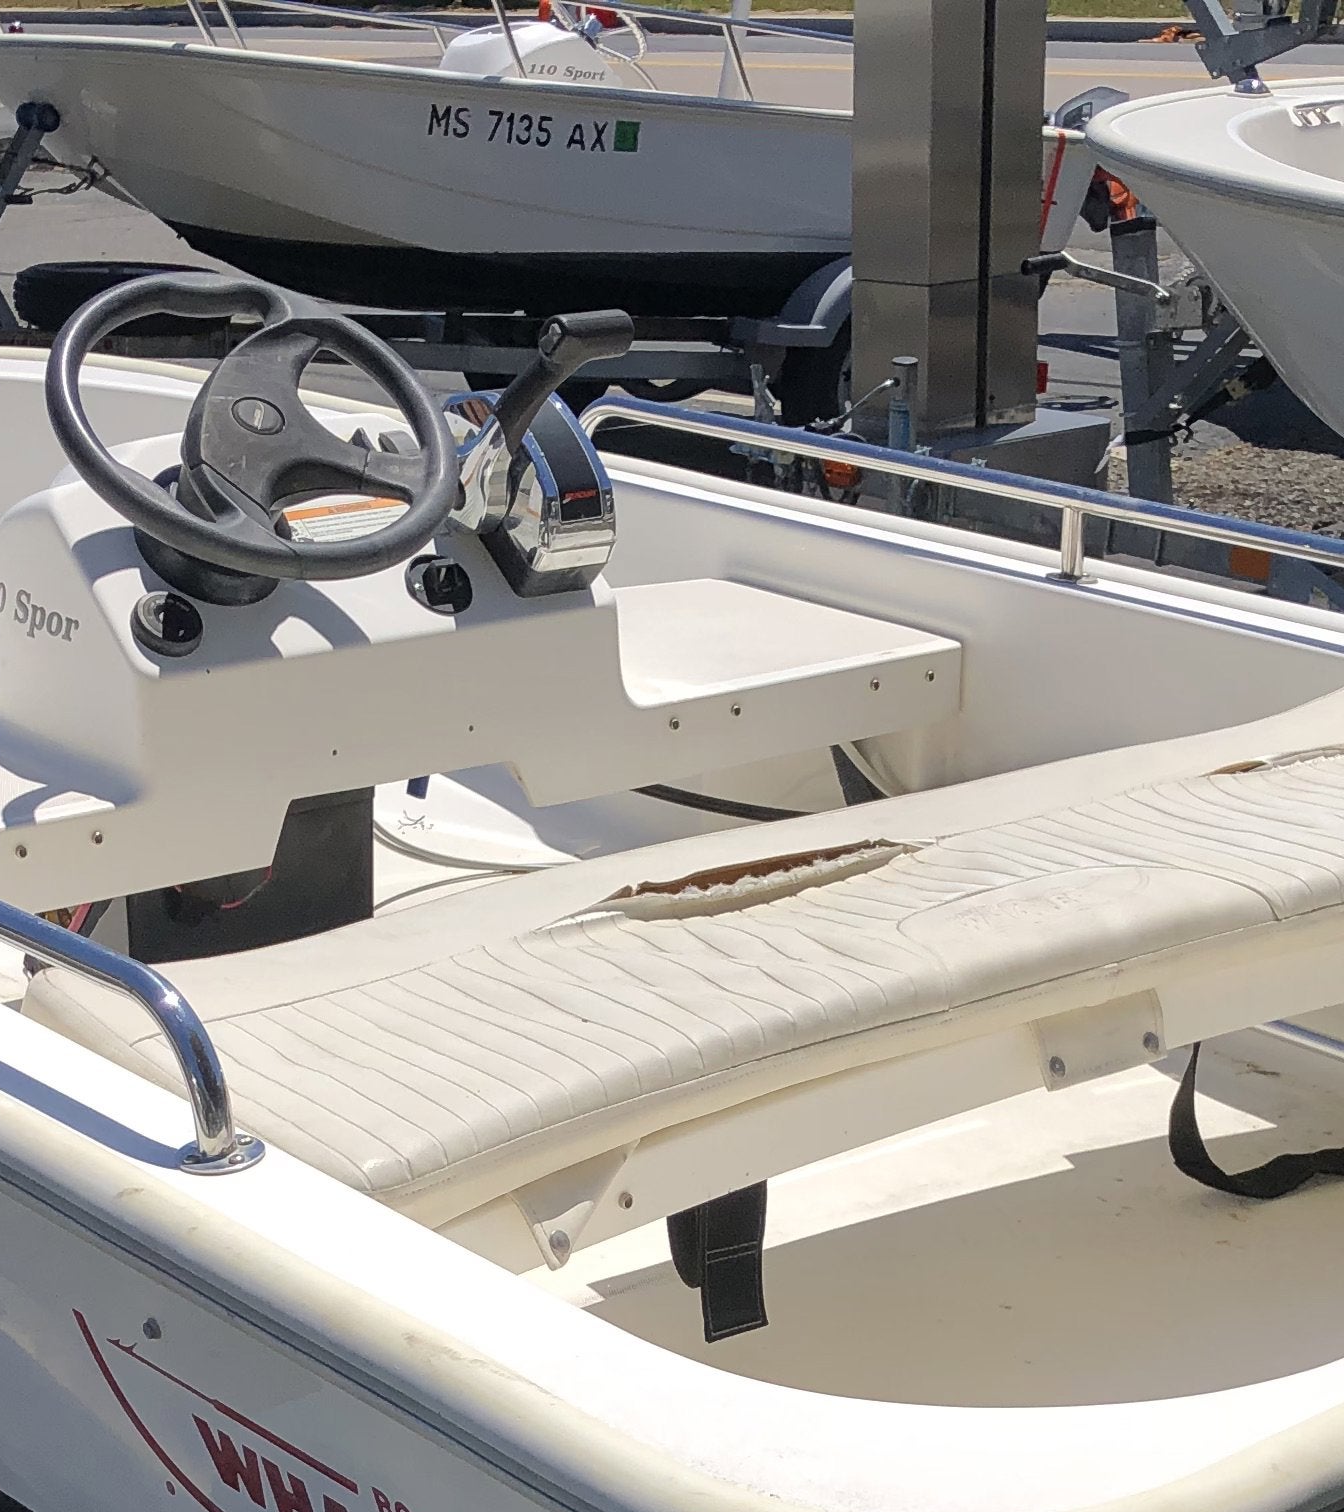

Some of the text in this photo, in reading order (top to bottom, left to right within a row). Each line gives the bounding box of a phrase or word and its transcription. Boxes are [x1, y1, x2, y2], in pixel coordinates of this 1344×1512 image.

[527, 63, 606, 81] 110 Sport
[427, 103, 609, 153] MS 7135 AX
[13, 588, 80, 643] Spor
